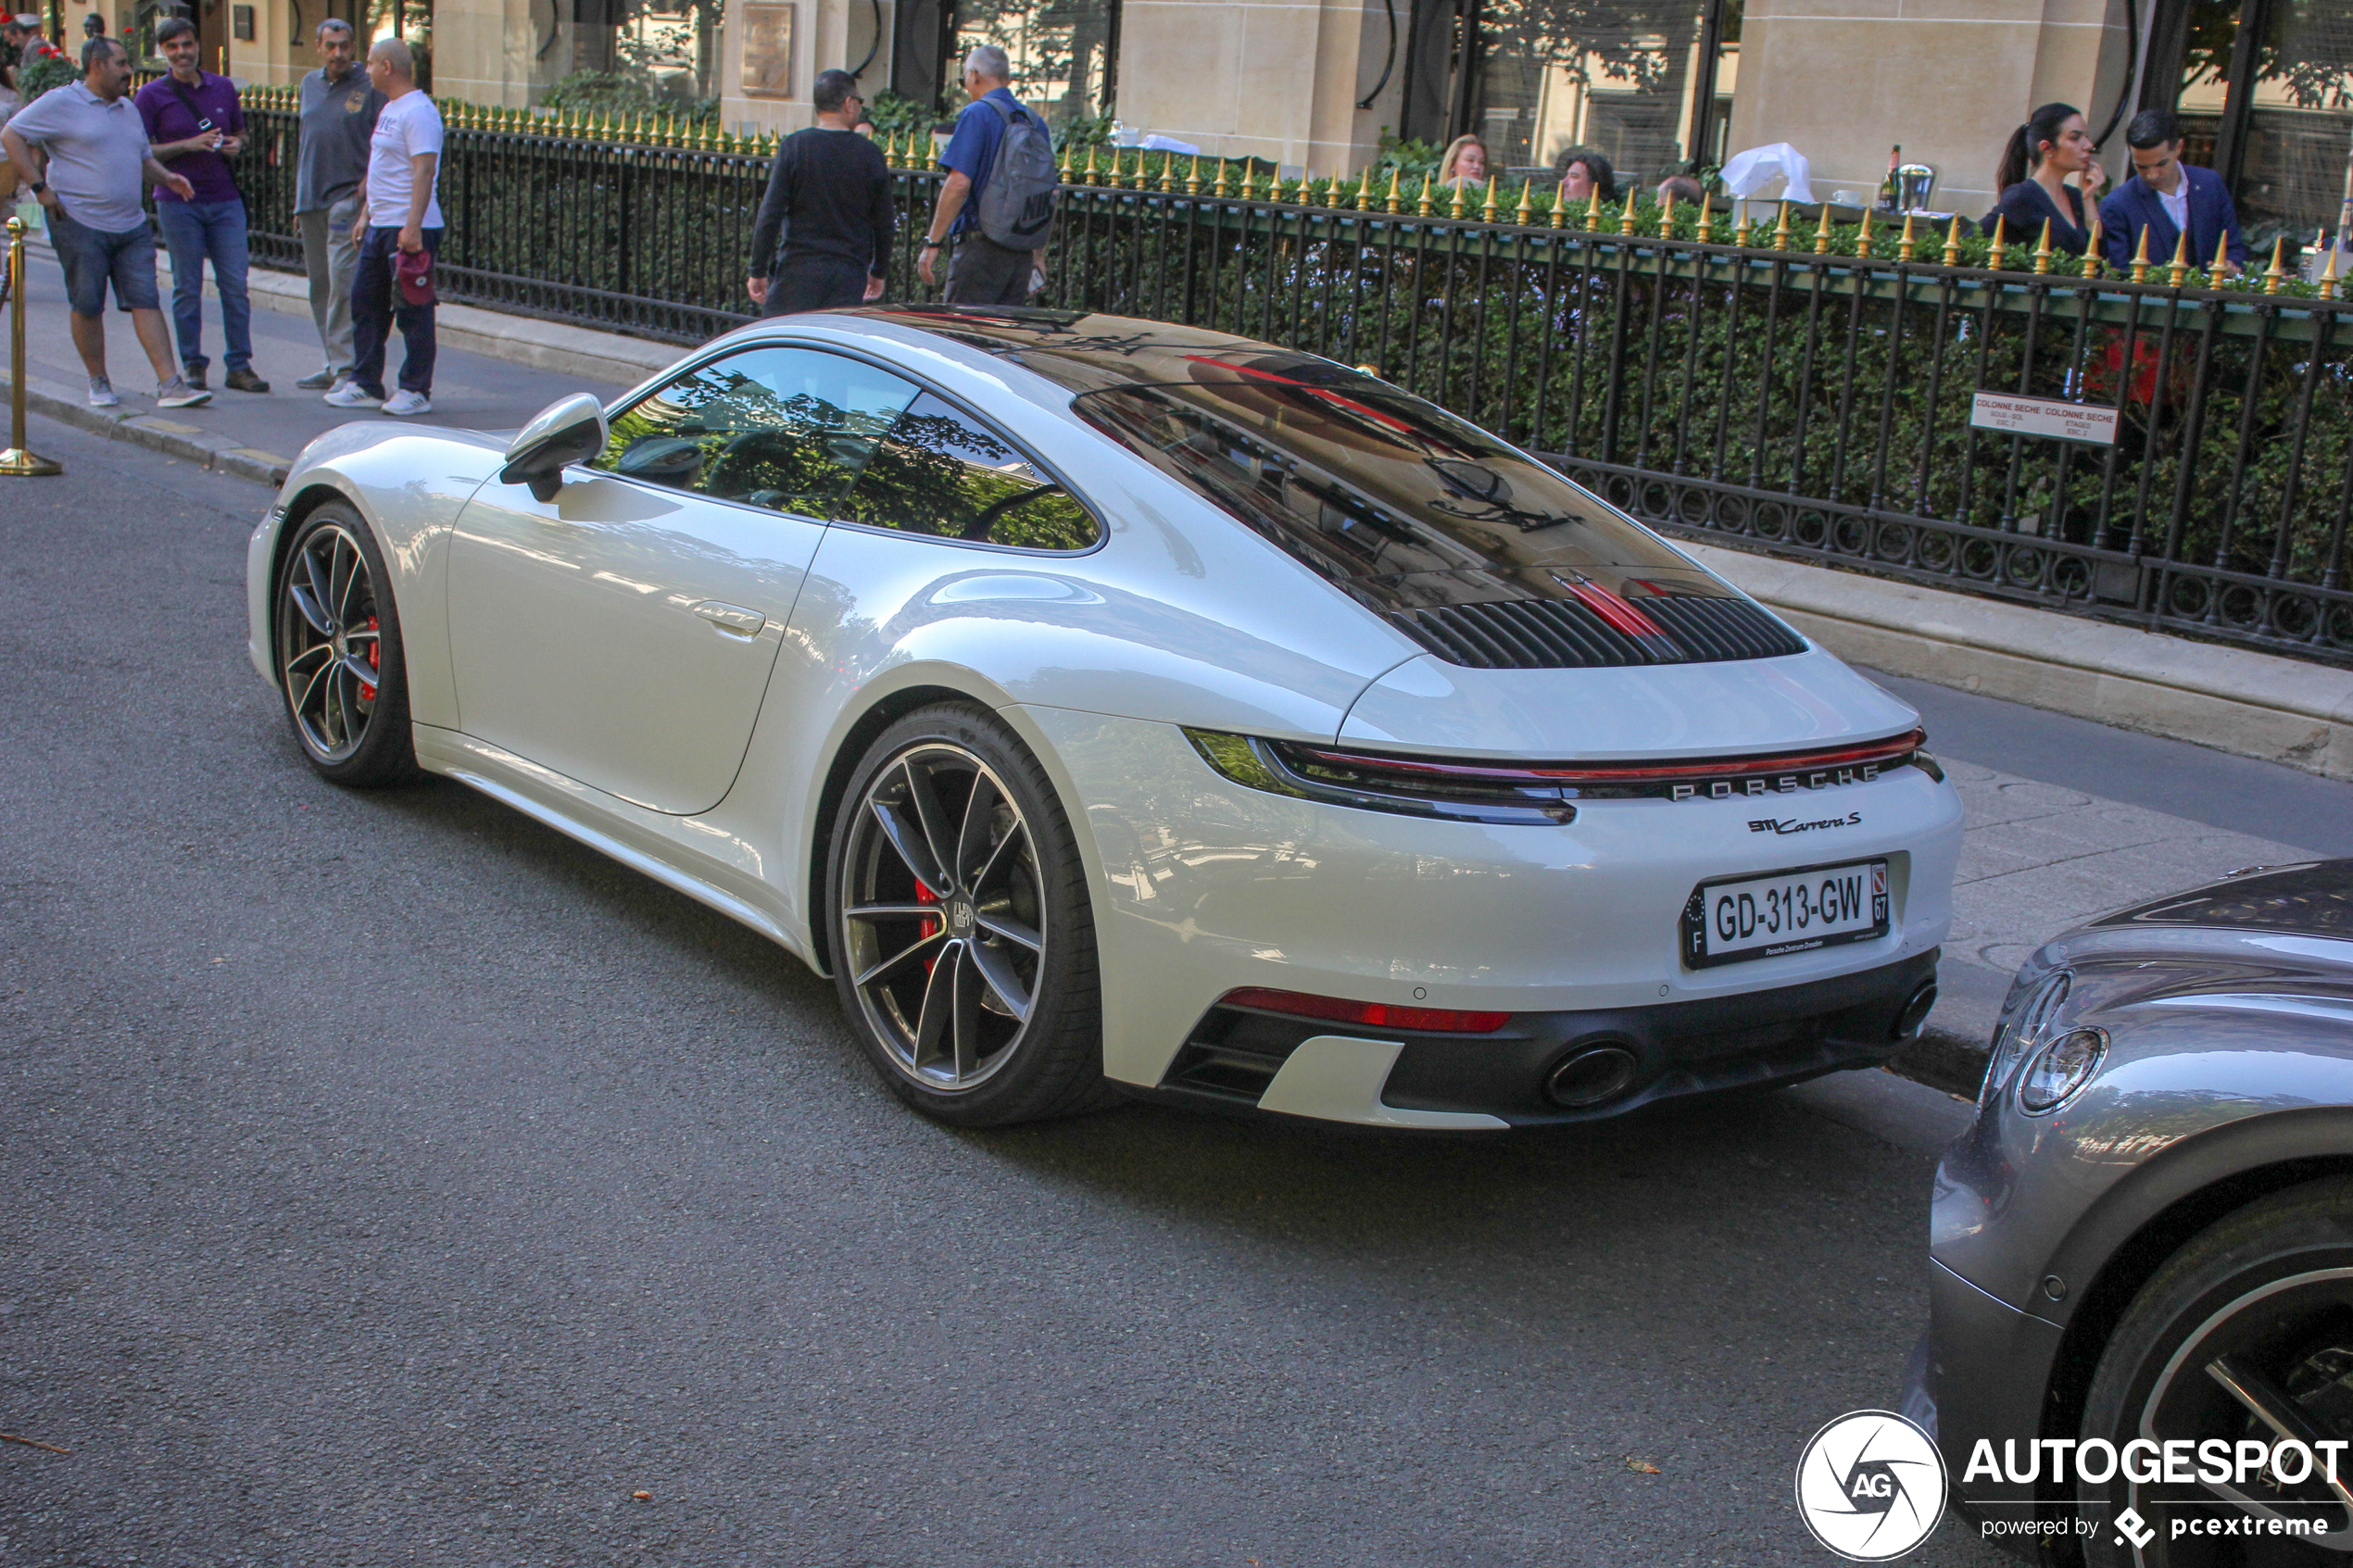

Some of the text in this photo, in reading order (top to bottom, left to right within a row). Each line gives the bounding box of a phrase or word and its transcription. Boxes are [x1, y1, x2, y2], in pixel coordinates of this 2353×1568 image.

[1976, 399, 2041, 414] COLONNE SECHE
[2045, 408, 2114, 423] COLONNE SECHE
[2066, 420, 2091, 429] ETAGES
[1673, 765, 1879, 801] PORSCHE
[1776, 819, 1845, 834] Carrera
[1846, 811, 1862, 825] S
[1717, 875, 1862, 942] GD-313-GW
[1874, 896, 1887, 921] 67
[1692, 931, 1702, 953] F
